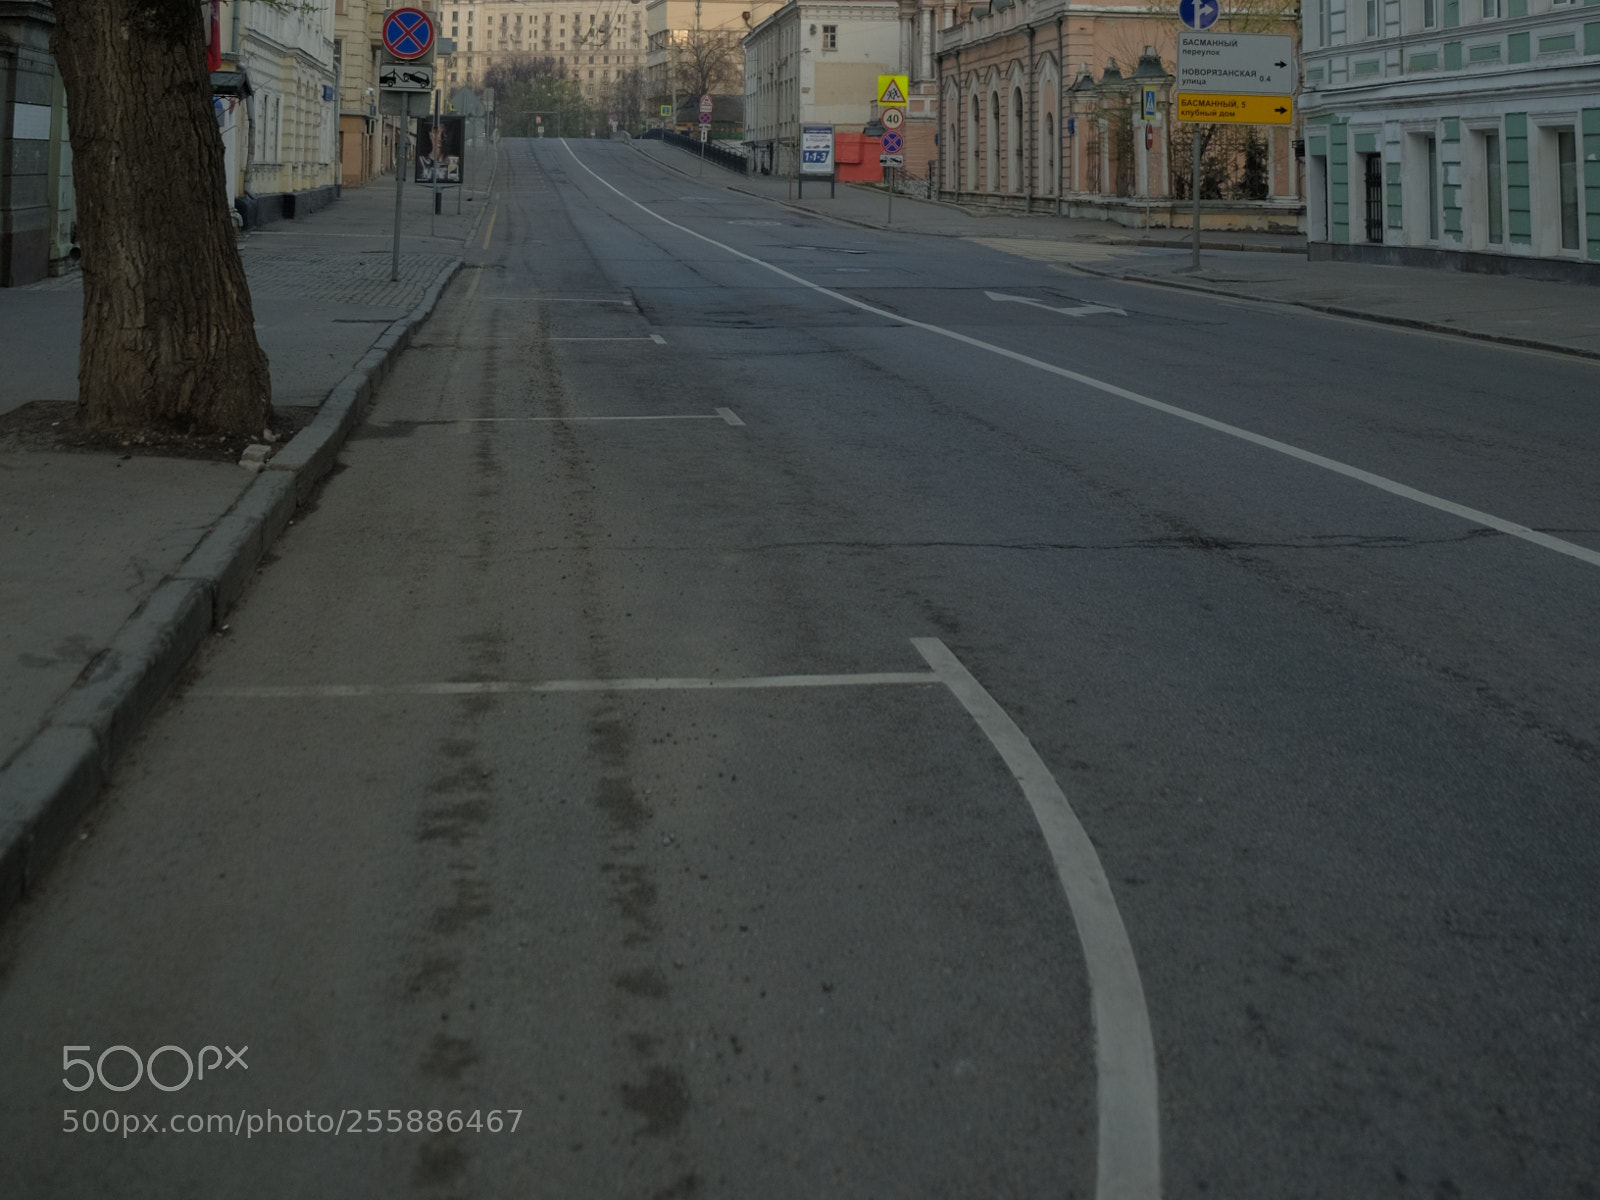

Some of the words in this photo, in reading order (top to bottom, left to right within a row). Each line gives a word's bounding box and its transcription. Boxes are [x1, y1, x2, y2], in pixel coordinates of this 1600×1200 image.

[1182, 38, 1238, 47] БАСМАННЫЙ
[1182, 68, 1257, 78] НОВОРЯЗАНСКАЯ
[1181, 99, 1240, 109] БАСМАННЫЙ,
[1241, 101, 1246, 109] 5
[886, 114, 899, 124] 40
[1181, 110, 1217, 118] клубный
